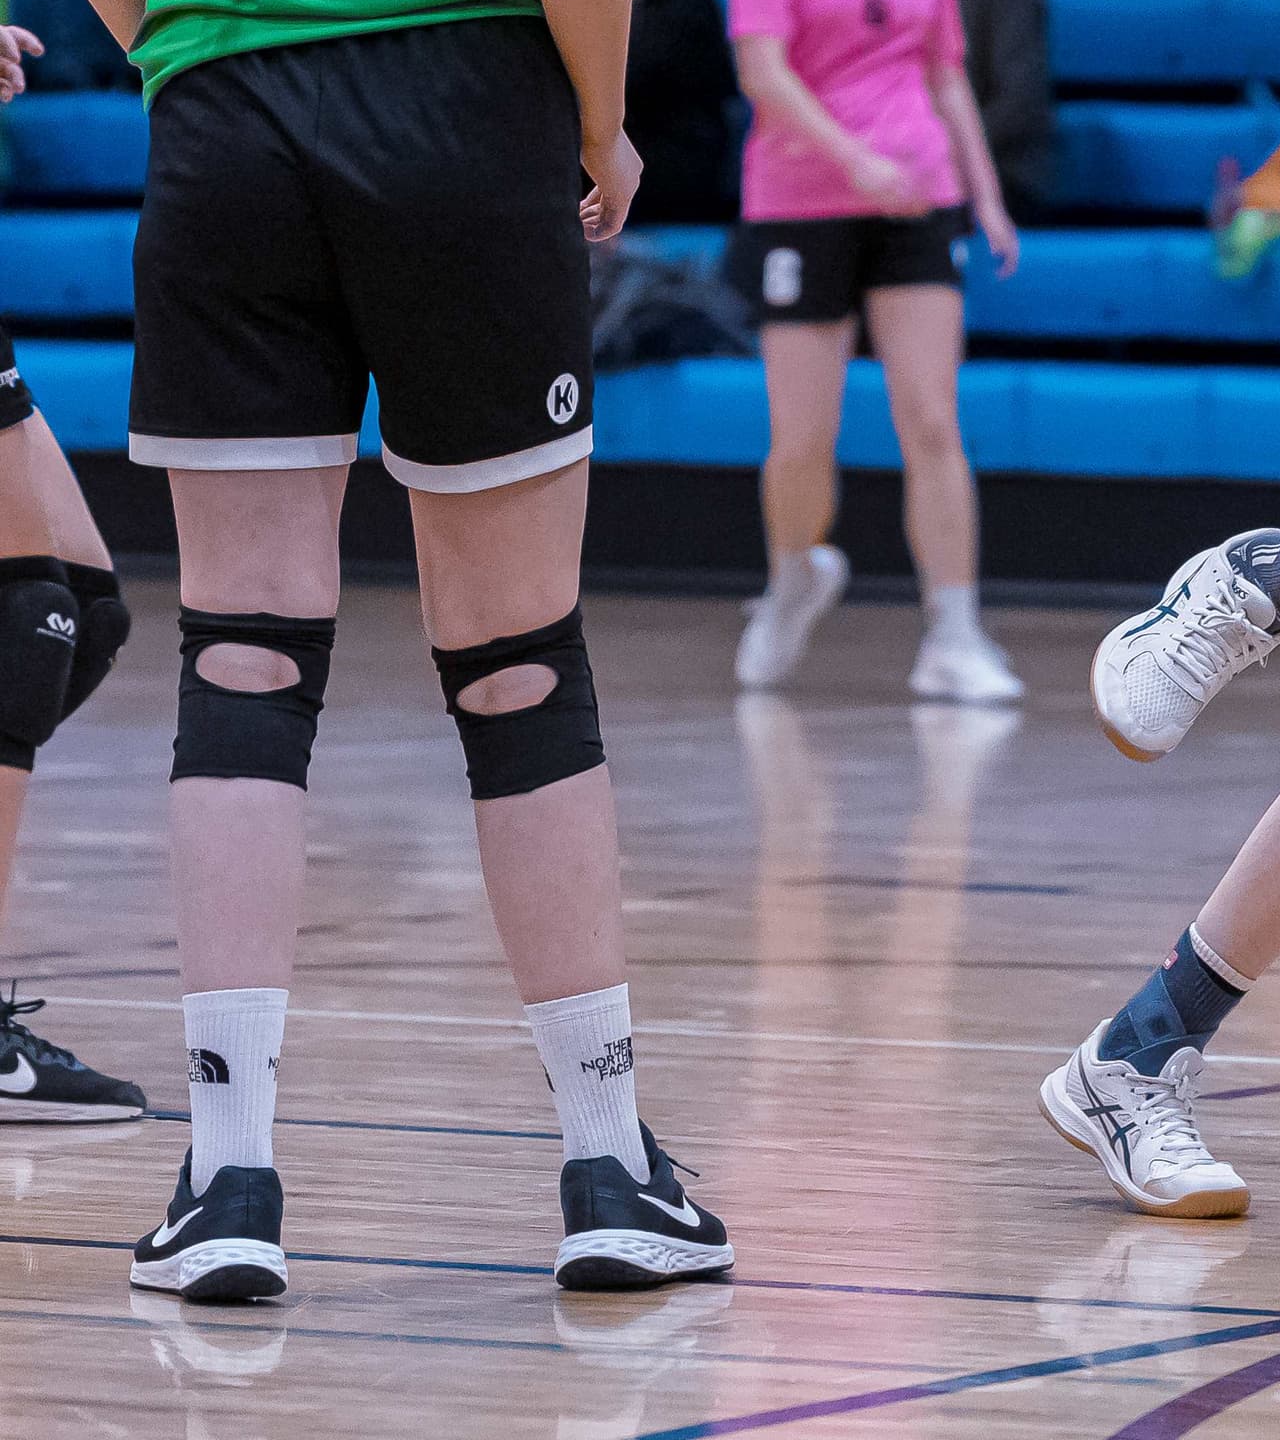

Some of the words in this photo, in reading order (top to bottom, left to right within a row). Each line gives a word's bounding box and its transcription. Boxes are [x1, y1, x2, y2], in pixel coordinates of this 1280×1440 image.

[603, 1038, 628, 1055] THE
[580, 1049, 629, 1073] NORTH
[599, 1060, 631, 1081] FACE
